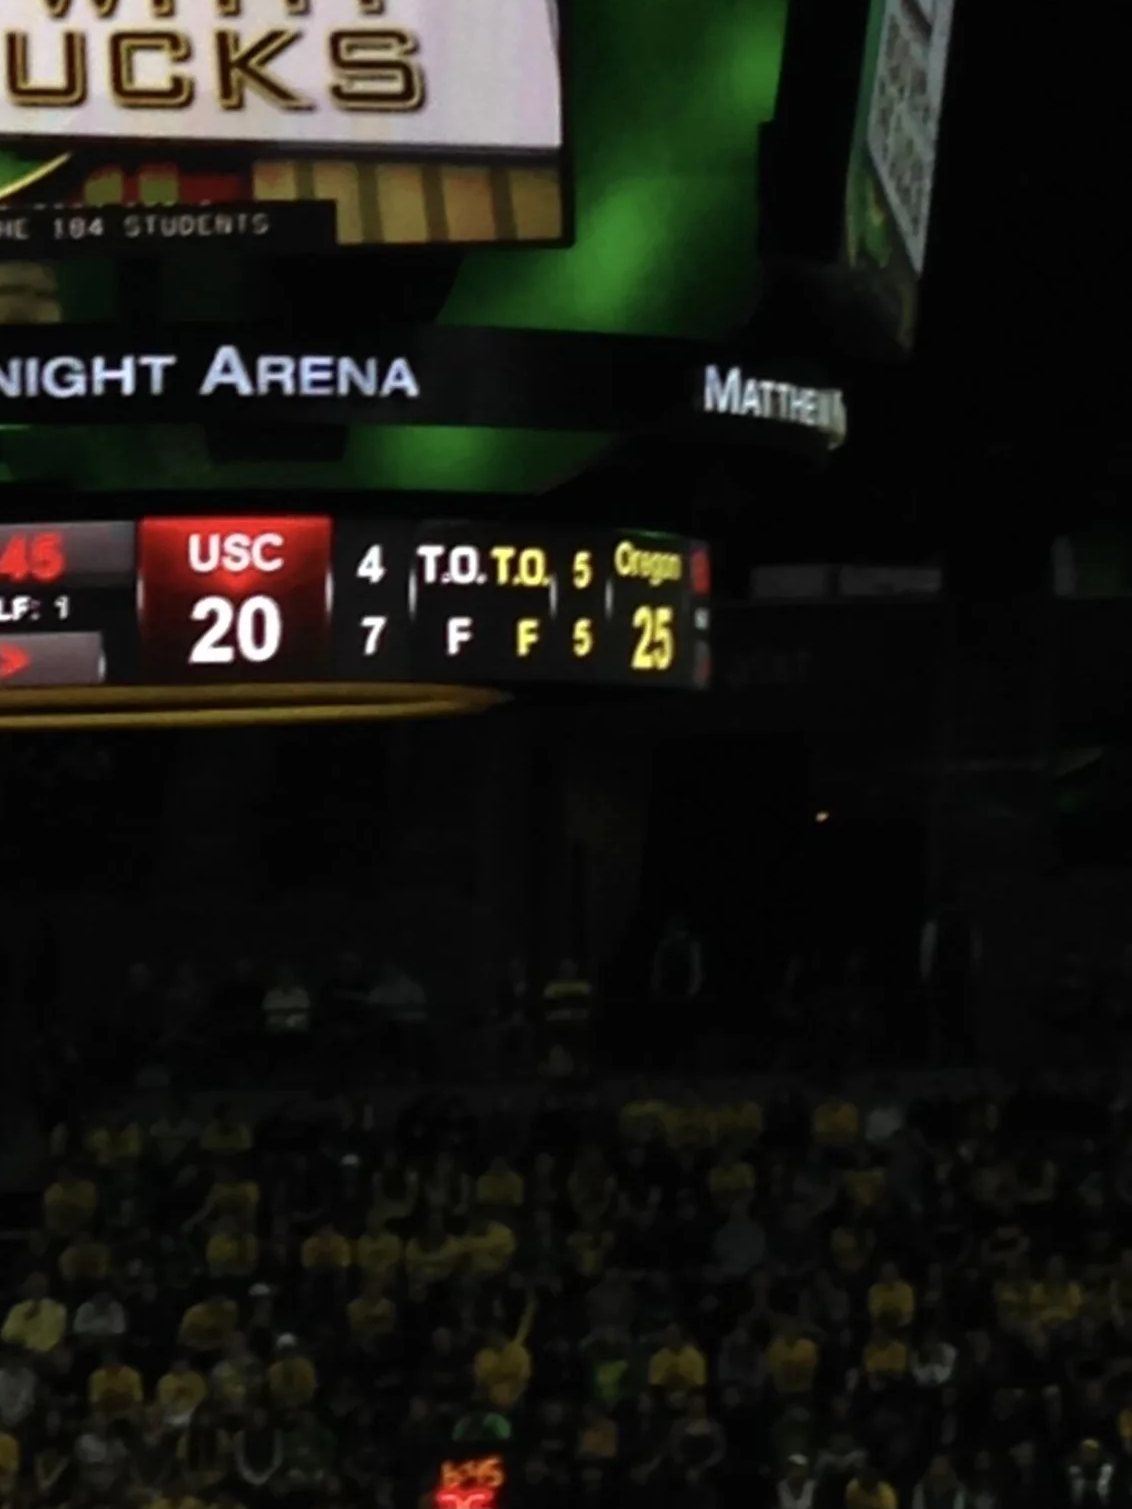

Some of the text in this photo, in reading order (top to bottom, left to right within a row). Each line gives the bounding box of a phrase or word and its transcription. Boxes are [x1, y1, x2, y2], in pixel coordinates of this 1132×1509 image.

[122, 213, 270, 238] STUDENTS
[200, 345, 420, 397] ARENA
[187, 533, 284, 573] USC
[356, 544, 593, 589] 4 T.O. T.O. 5
[614, 540, 683, 586] Oregon
[53, 595, 71, 620] 1
[188, 594, 283, 664] 20
[361, 615, 593, 657] 7 F F 5
[630, 605, 674, 670] 25
